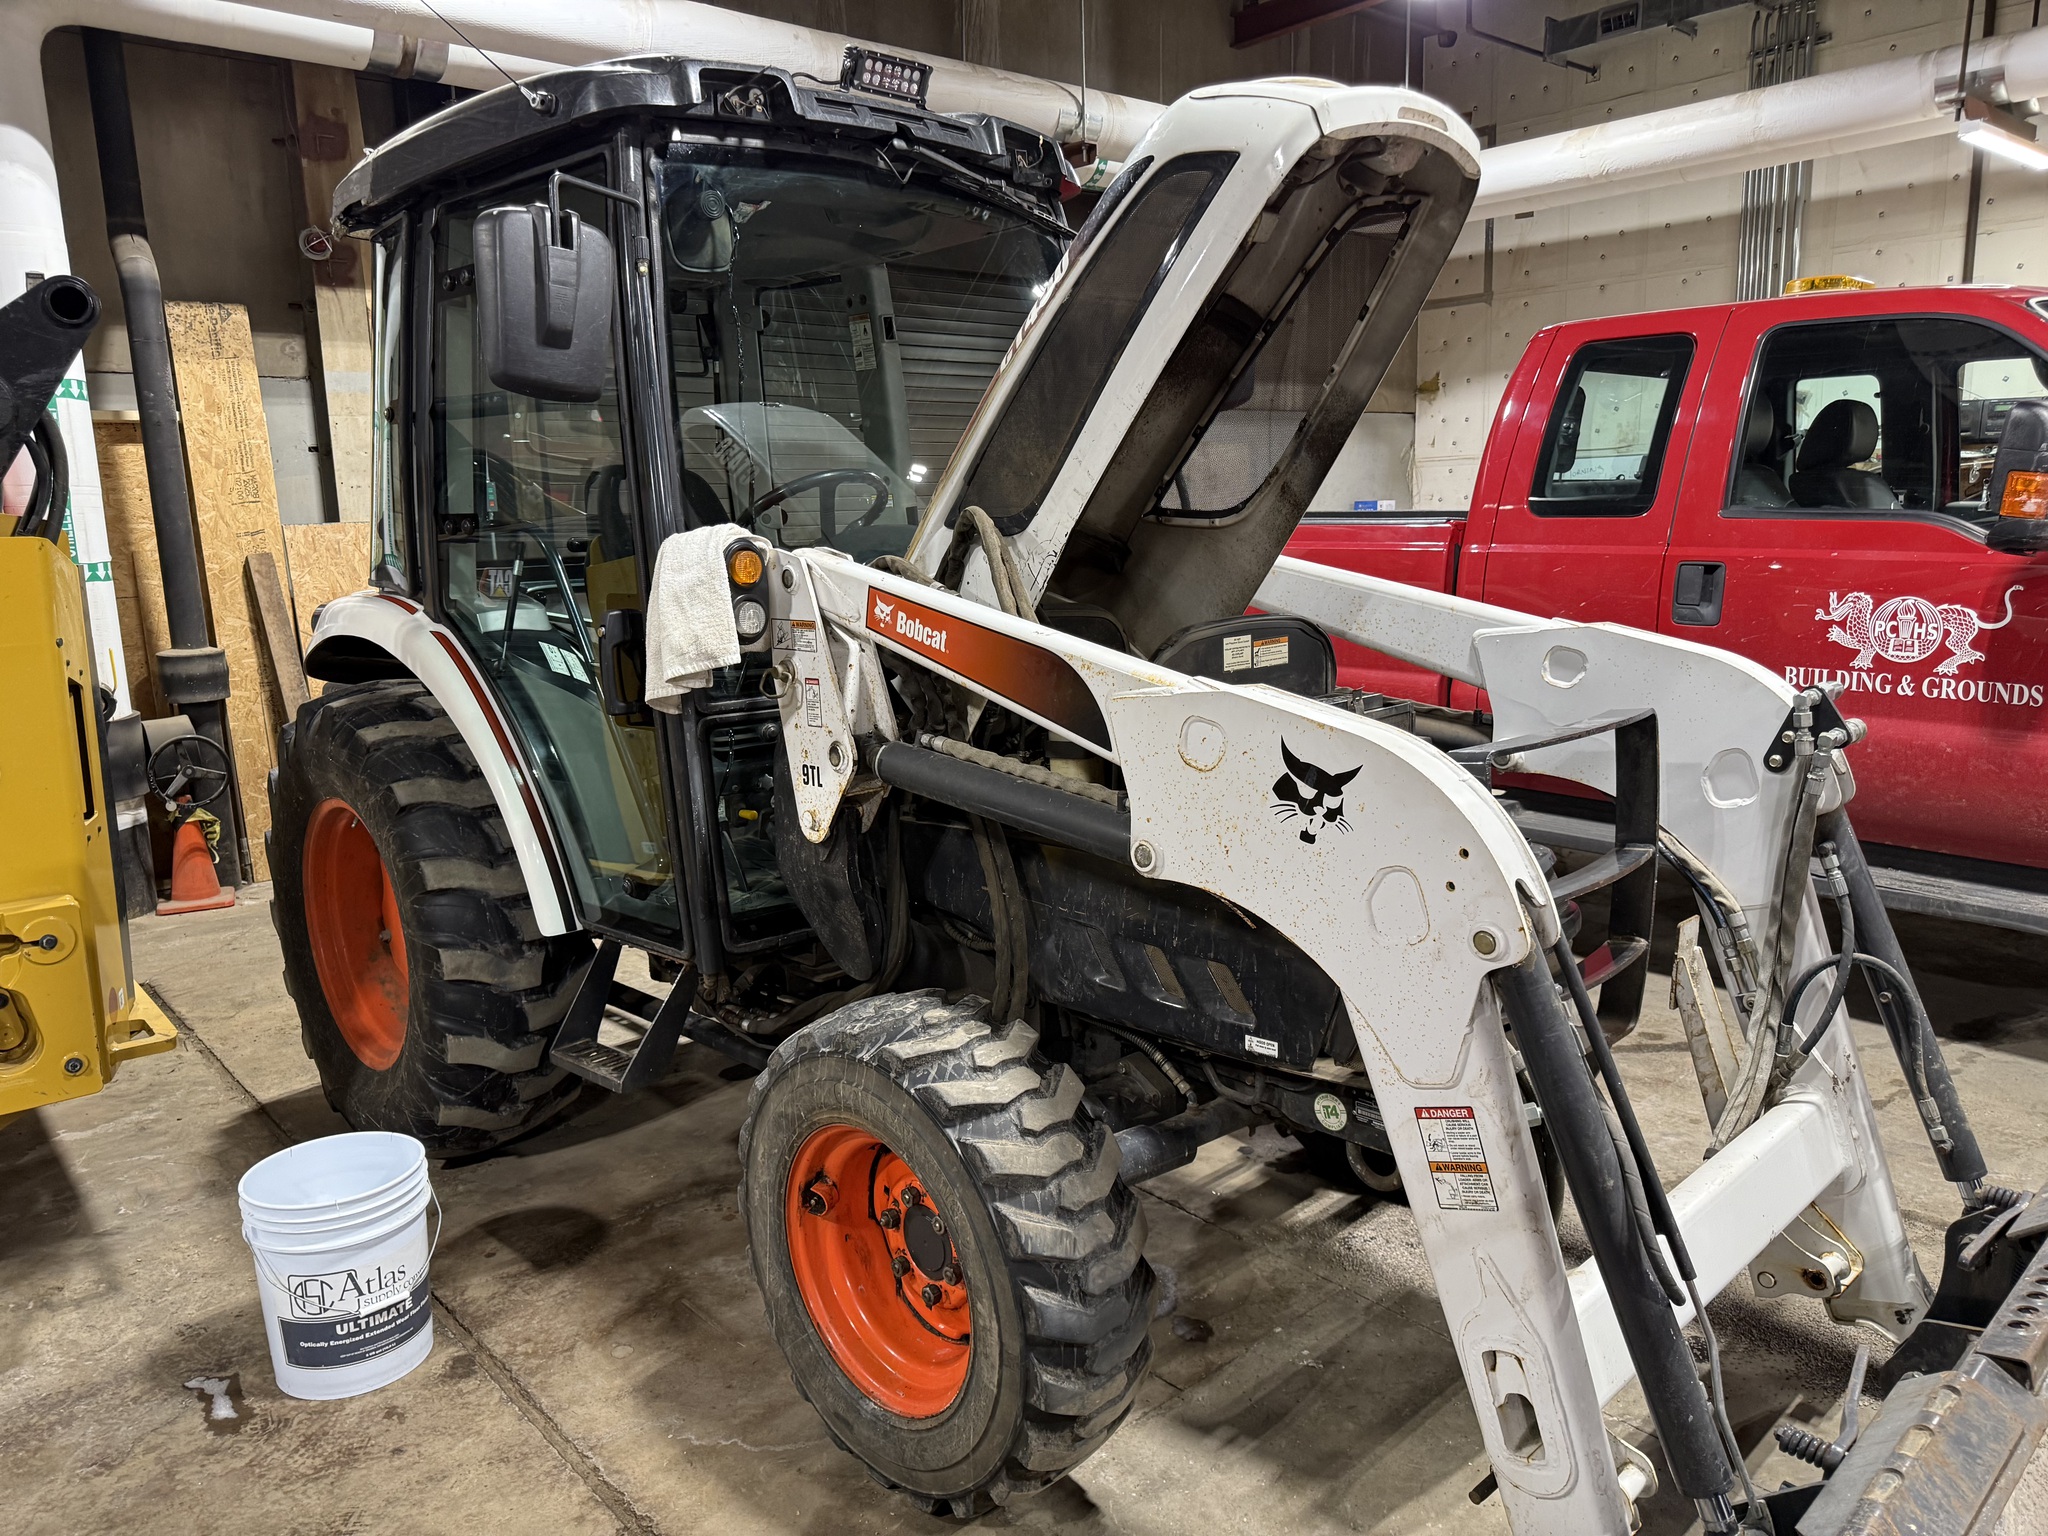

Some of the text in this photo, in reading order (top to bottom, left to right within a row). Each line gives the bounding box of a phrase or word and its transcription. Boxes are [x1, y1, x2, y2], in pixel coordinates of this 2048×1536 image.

[896, 610, 948, 653] Bobcat
[1784, 666, 2044, 708] BUILDING & GROUNDS
[802, 764, 823, 788] 9TL
[1429, 1109, 1469, 1118] DANGER
[1442, 1163, 1483, 1172] WARNING
[338, 1264, 407, 1302] Atlas
[335, 1296, 413, 1335] ULTIMATE
[330, 1334, 364, 1346] Energized
[365, 1322, 395, 1338] Extended
